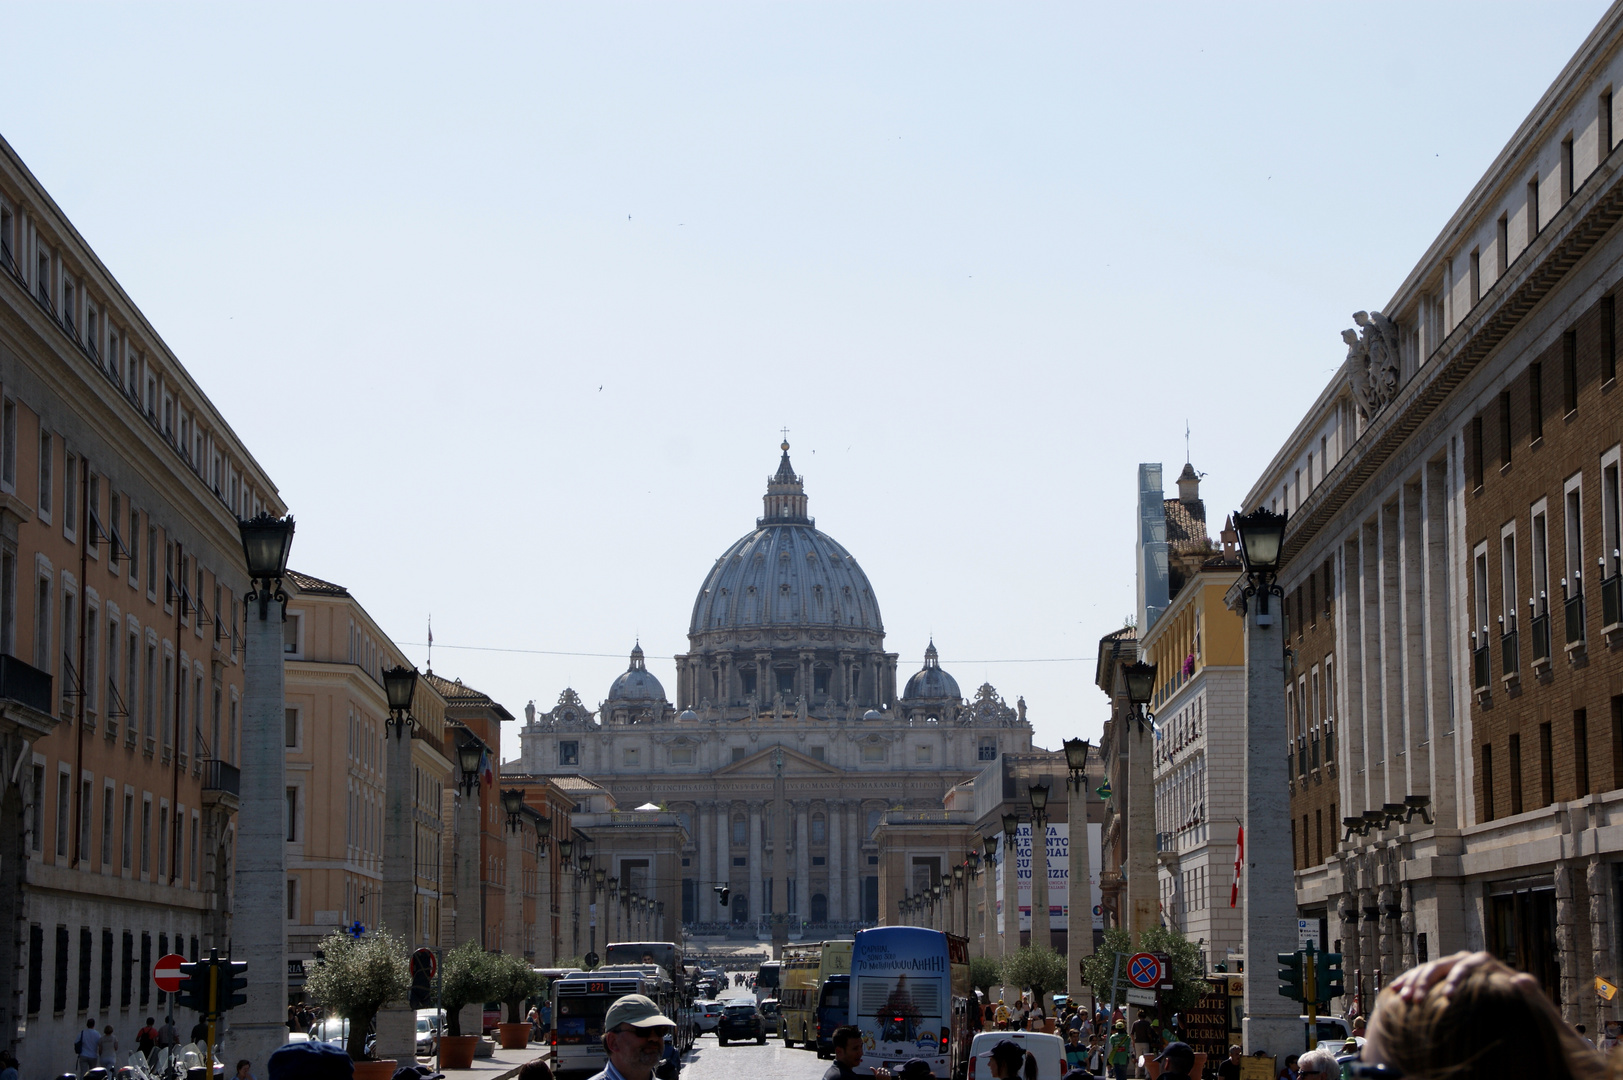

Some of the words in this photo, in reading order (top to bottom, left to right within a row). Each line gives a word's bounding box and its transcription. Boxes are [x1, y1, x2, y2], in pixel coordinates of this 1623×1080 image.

[1016, 827, 1058, 836] ARVA
[1016, 837, 1069, 847] L'ENTO
[591, 982, 604, 992] 271
[1194, 999, 1225, 1010] BITE
[1186, 1013, 1225, 1025] DRINKS
[1186, 1028, 1199, 1039] ICE
[1199, 1029, 1225, 1040] CREAM
